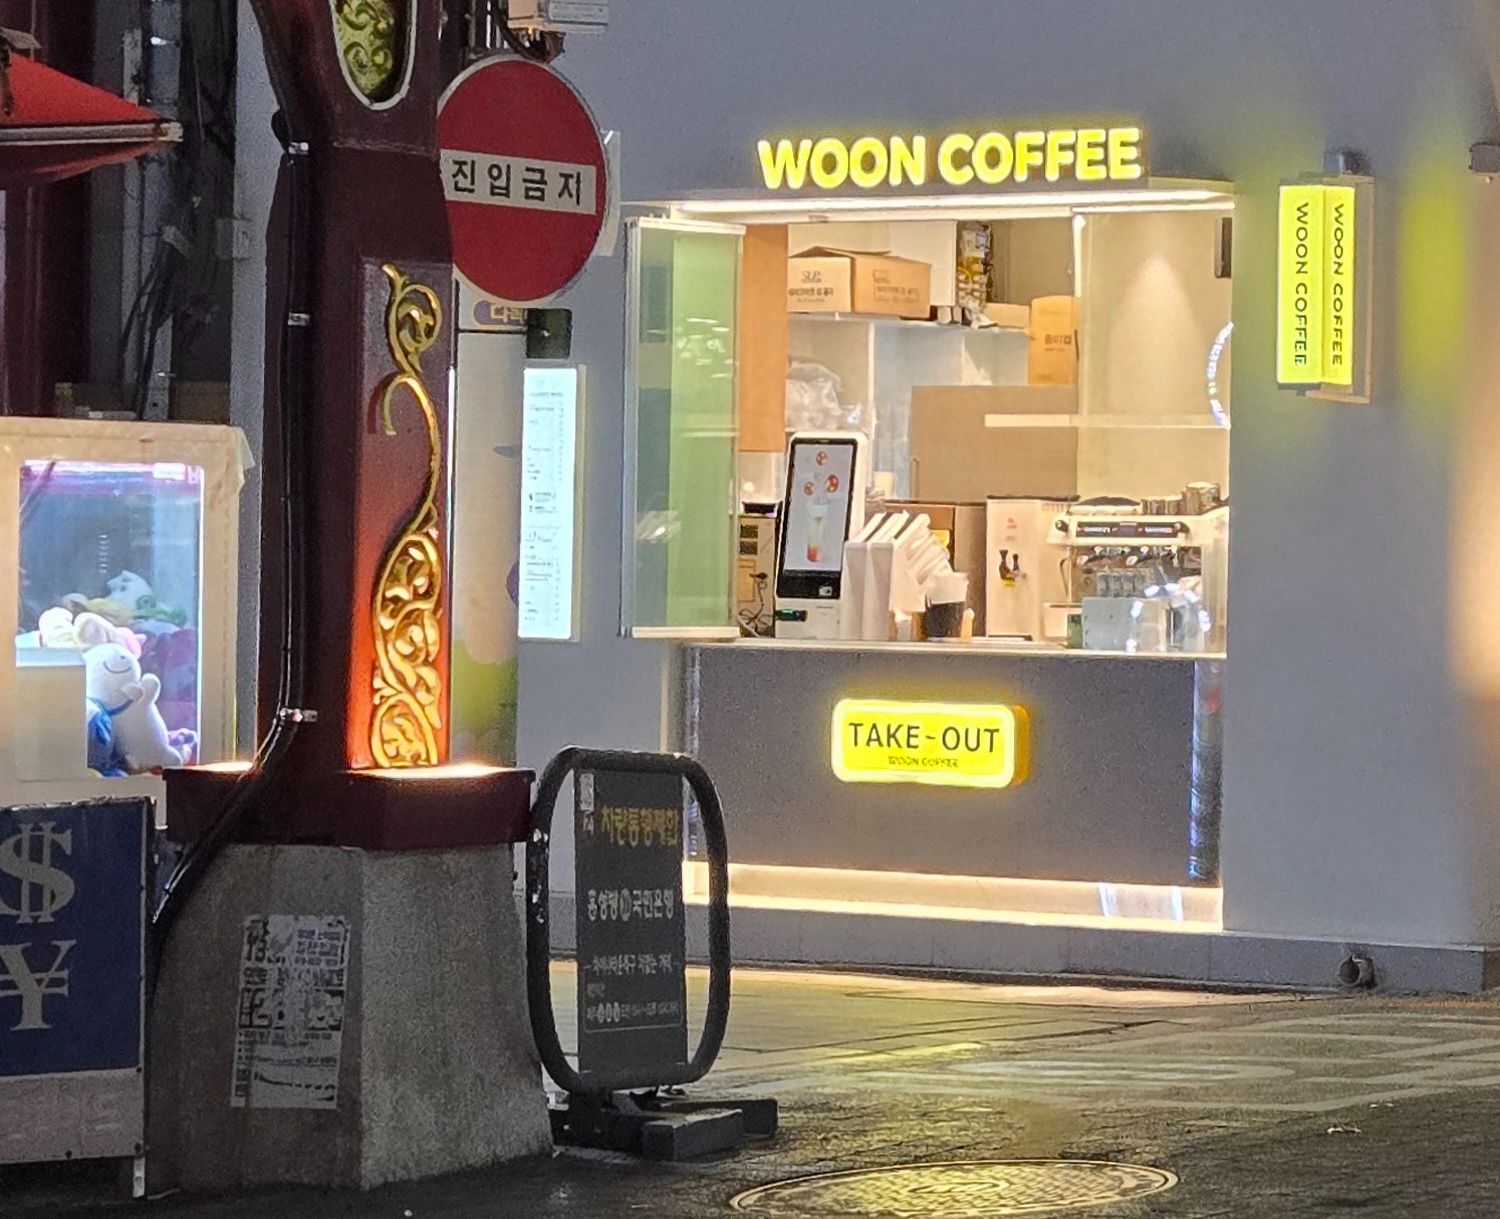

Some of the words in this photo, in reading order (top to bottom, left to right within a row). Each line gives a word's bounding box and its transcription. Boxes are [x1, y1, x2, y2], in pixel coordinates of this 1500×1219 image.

[451, 158, 583, 207] 진입금지
[757, 135, 928, 189] WOON
[937, 127, 1143, 184] COFFEE
[1296, 202, 1309, 275] WOON
[1333, 203, 1345, 276] WOON
[1332, 282, 1344, 366] COFFEE
